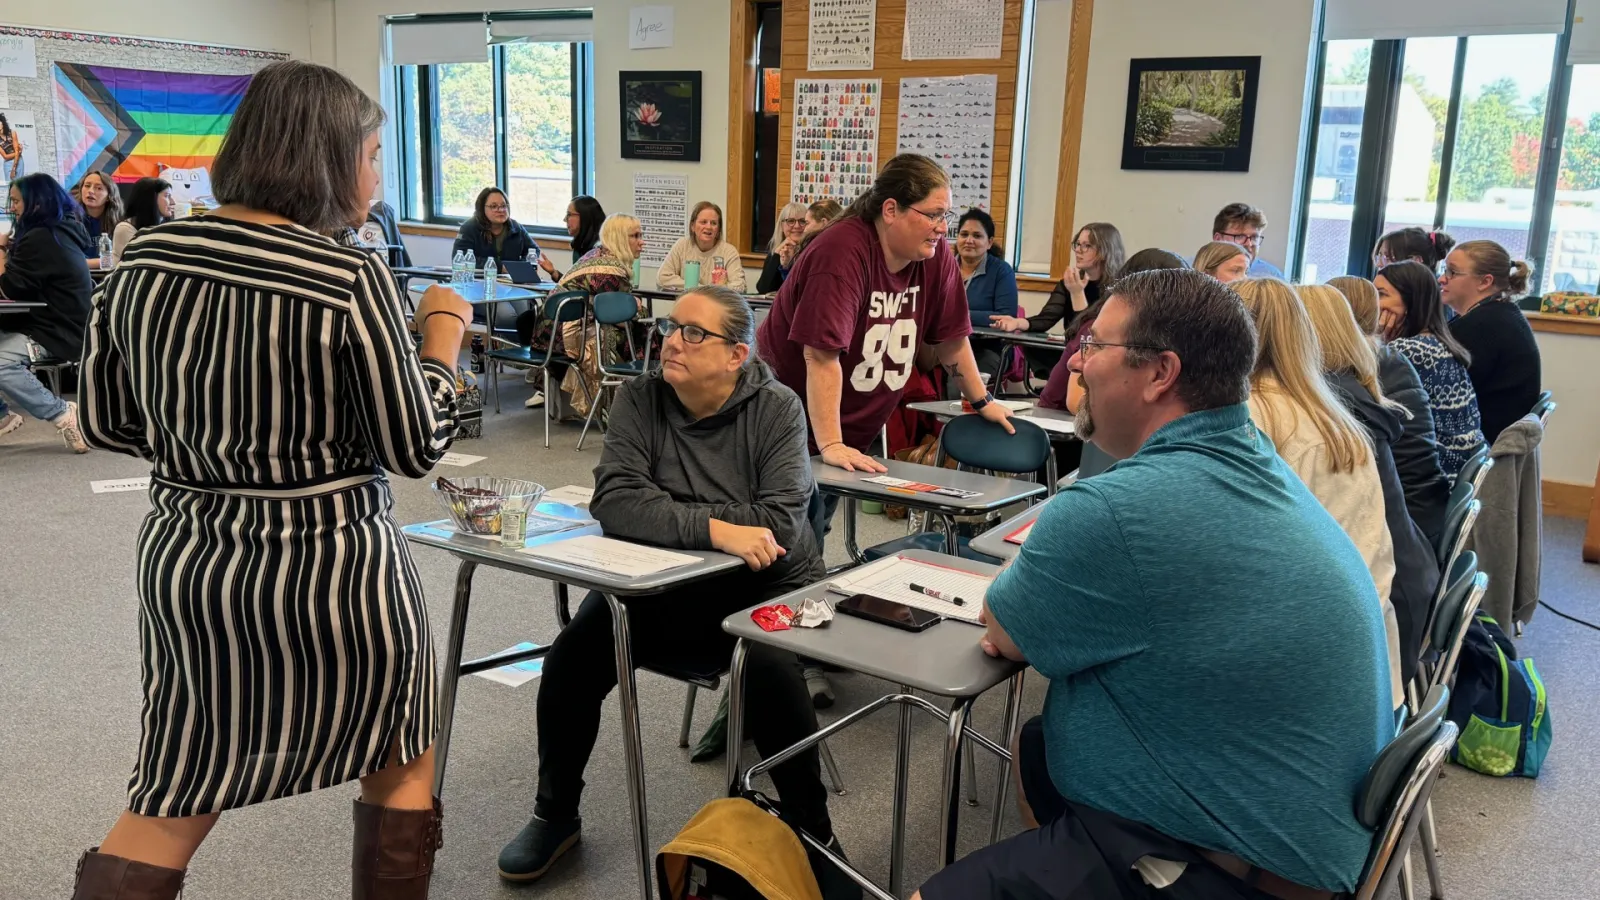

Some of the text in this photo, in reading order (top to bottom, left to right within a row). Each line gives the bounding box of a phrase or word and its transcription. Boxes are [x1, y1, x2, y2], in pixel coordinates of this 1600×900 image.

[635, 17, 666, 41] Agree
[869, 286, 920, 318] SWFT
[850, 319, 917, 392] 89
